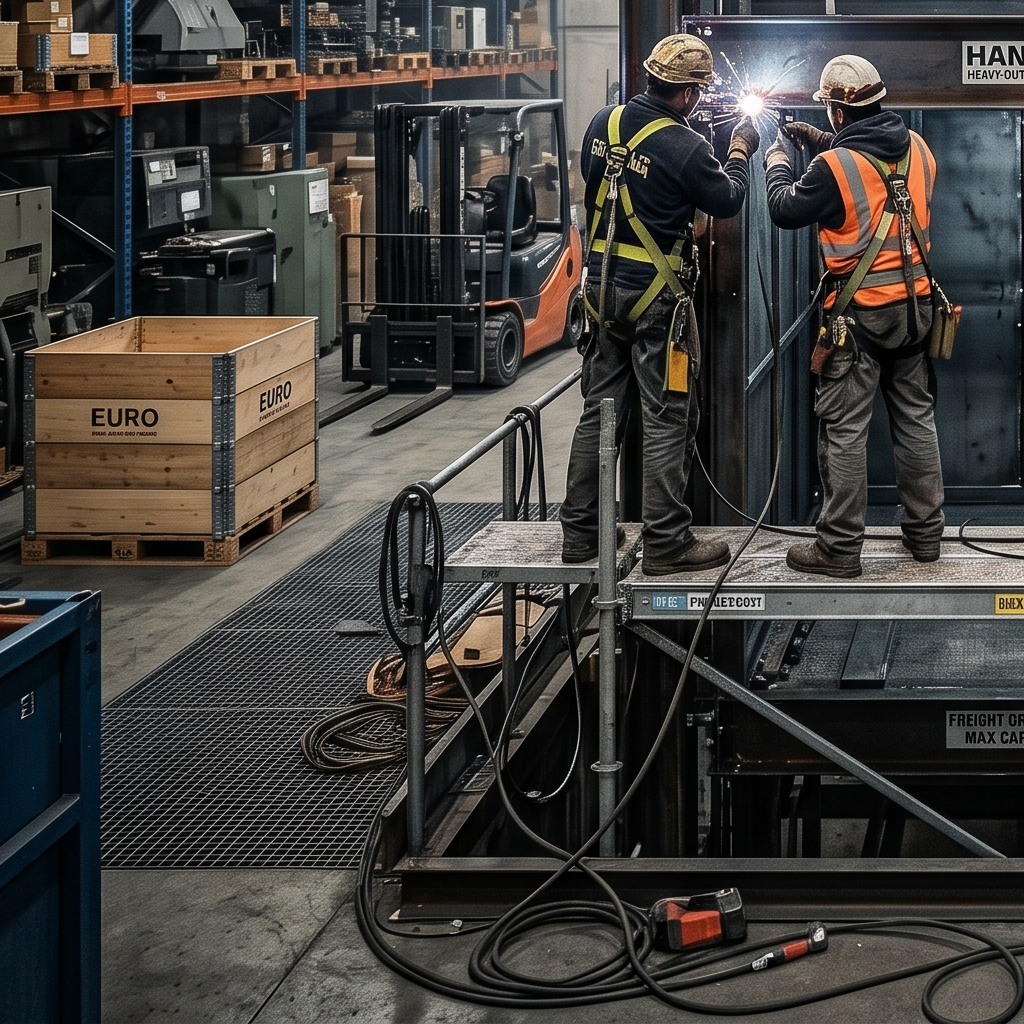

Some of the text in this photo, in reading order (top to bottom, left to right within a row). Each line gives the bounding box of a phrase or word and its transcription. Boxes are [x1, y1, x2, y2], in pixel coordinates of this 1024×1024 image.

[259, 380, 292, 413] EURO
[91, 408, 159, 427] EURO
[949, 713, 1004, 726] FREIGHT
[965, 731, 996, 744] MAX
